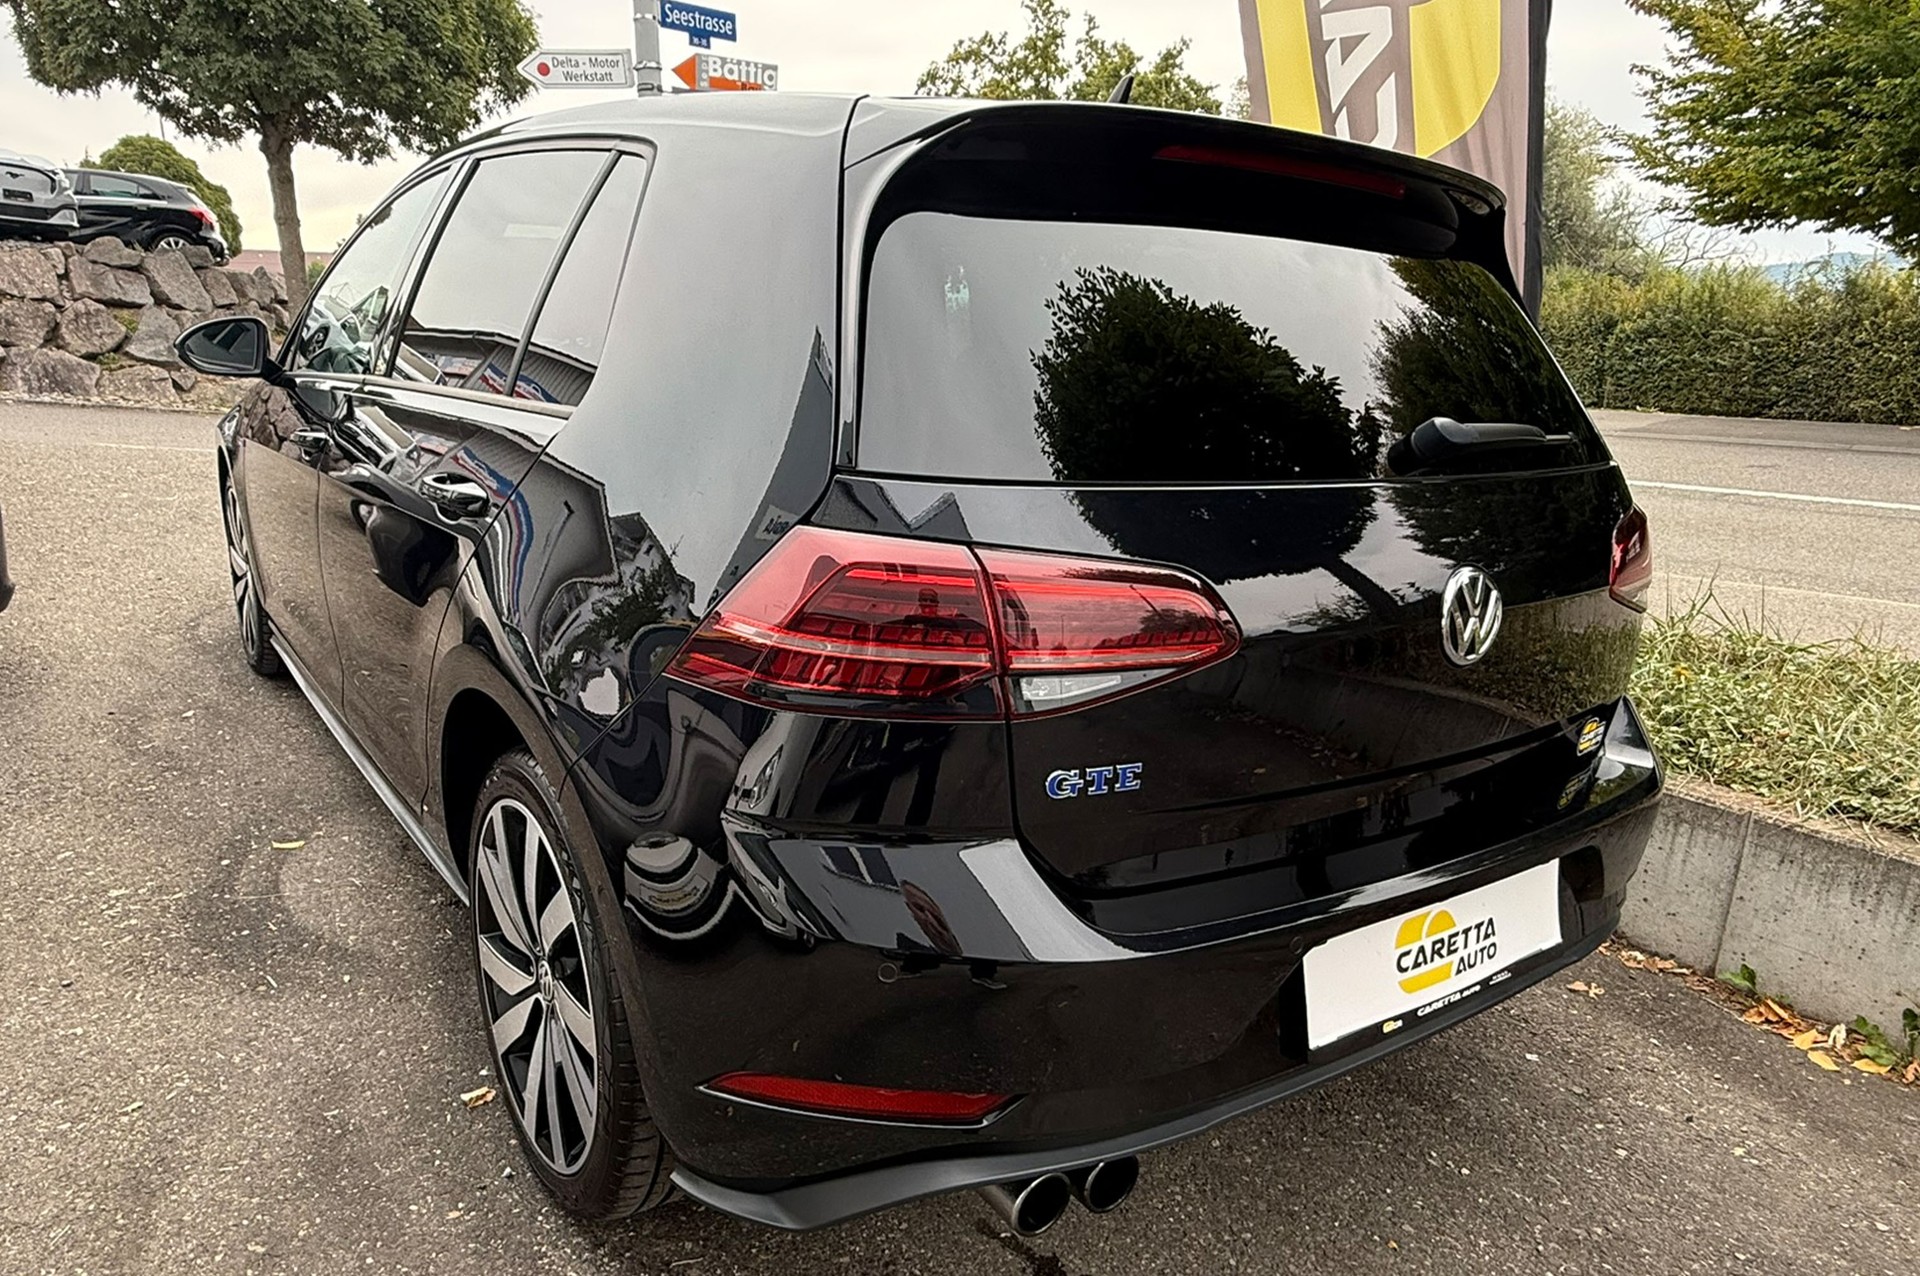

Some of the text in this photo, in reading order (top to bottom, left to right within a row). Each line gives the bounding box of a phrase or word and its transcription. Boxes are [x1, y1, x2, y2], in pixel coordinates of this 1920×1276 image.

[664, 3, 733, 35] Seestrasse
[551, 56, 580, 69] Delta
[589, 57, 620, 69] Motor
[562, 70, 613, 82] Werkstatt
[708, 56, 777, 91] Bättig
[1045, 763, 1143, 799] GTE
[1396, 917, 1496, 974] CARETTA
[1455, 942, 1497, 976] AUTO
